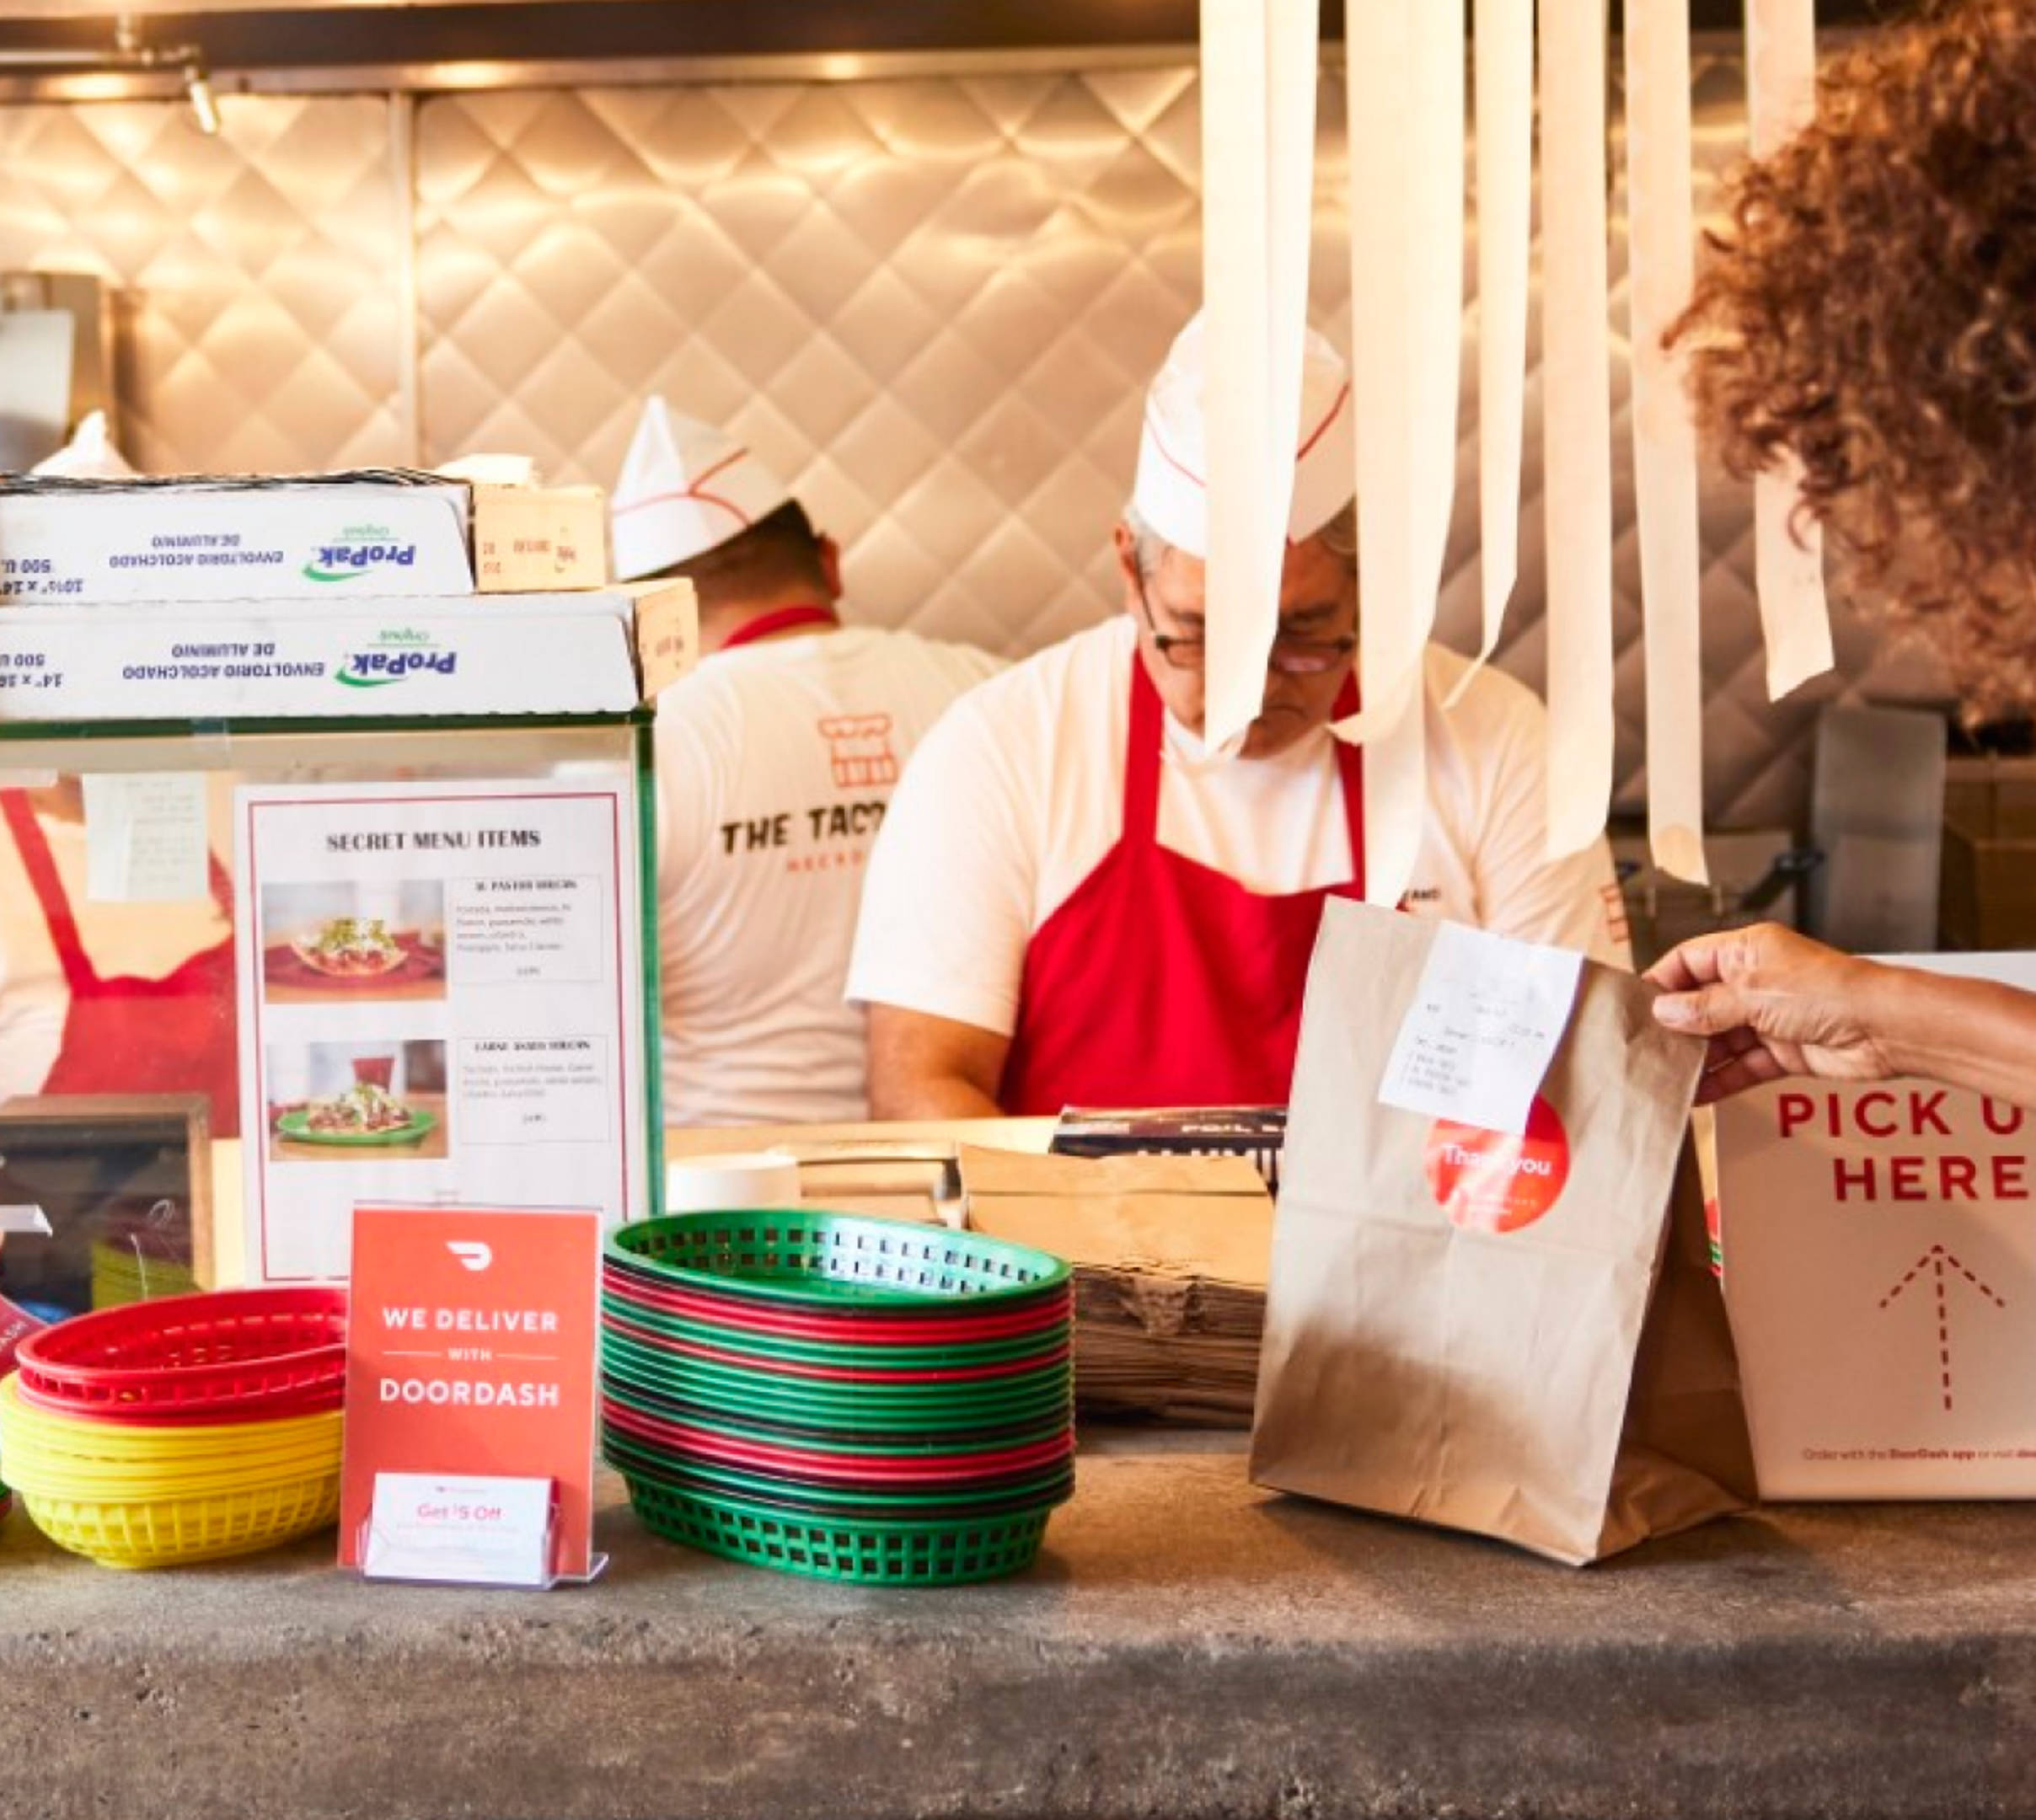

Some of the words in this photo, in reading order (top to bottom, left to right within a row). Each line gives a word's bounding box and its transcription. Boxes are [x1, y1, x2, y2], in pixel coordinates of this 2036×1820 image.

[218, 533, 240, 547] DE
[110, 553, 192, 569] ACOLCHADO
[197, 550, 284, 565] ENVOLTORIO
[317, 544, 417, 568] ProPak
[20, 559, 51, 574] 500
[171, 644, 249, 658] ALUMINIO
[253, 643, 275, 657] DE
[14, 653, 45, 666] 500
[351, 651, 458, 676] ProPak
[122, 664, 219, 680] ACOLCHADO
[223, 662, 324, 677] ENVOLTORIO
[327, 832, 406, 853] SECRET
[412, 831, 470, 851] MENU
[478, 829, 541, 848] ITEMS
[721, 813, 790, 855] THE
[1778, 1090, 1952, 1139] PICK
[1507, 1157, 1551, 1176] you
[1833, 1154, 2030, 1202] HERE
[383, 1308, 426, 1329] WE
[436, 1309, 558, 1331] DELIVER
[448, 1348, 492, 1362] WITH
[380, 1378, 559, 1406] DOORDASH
[1889, 1448, 1949, 1460] DoorDash
[1952, 1449, 1976, 1462] app
[418, 1503, 448, 1518] Get
